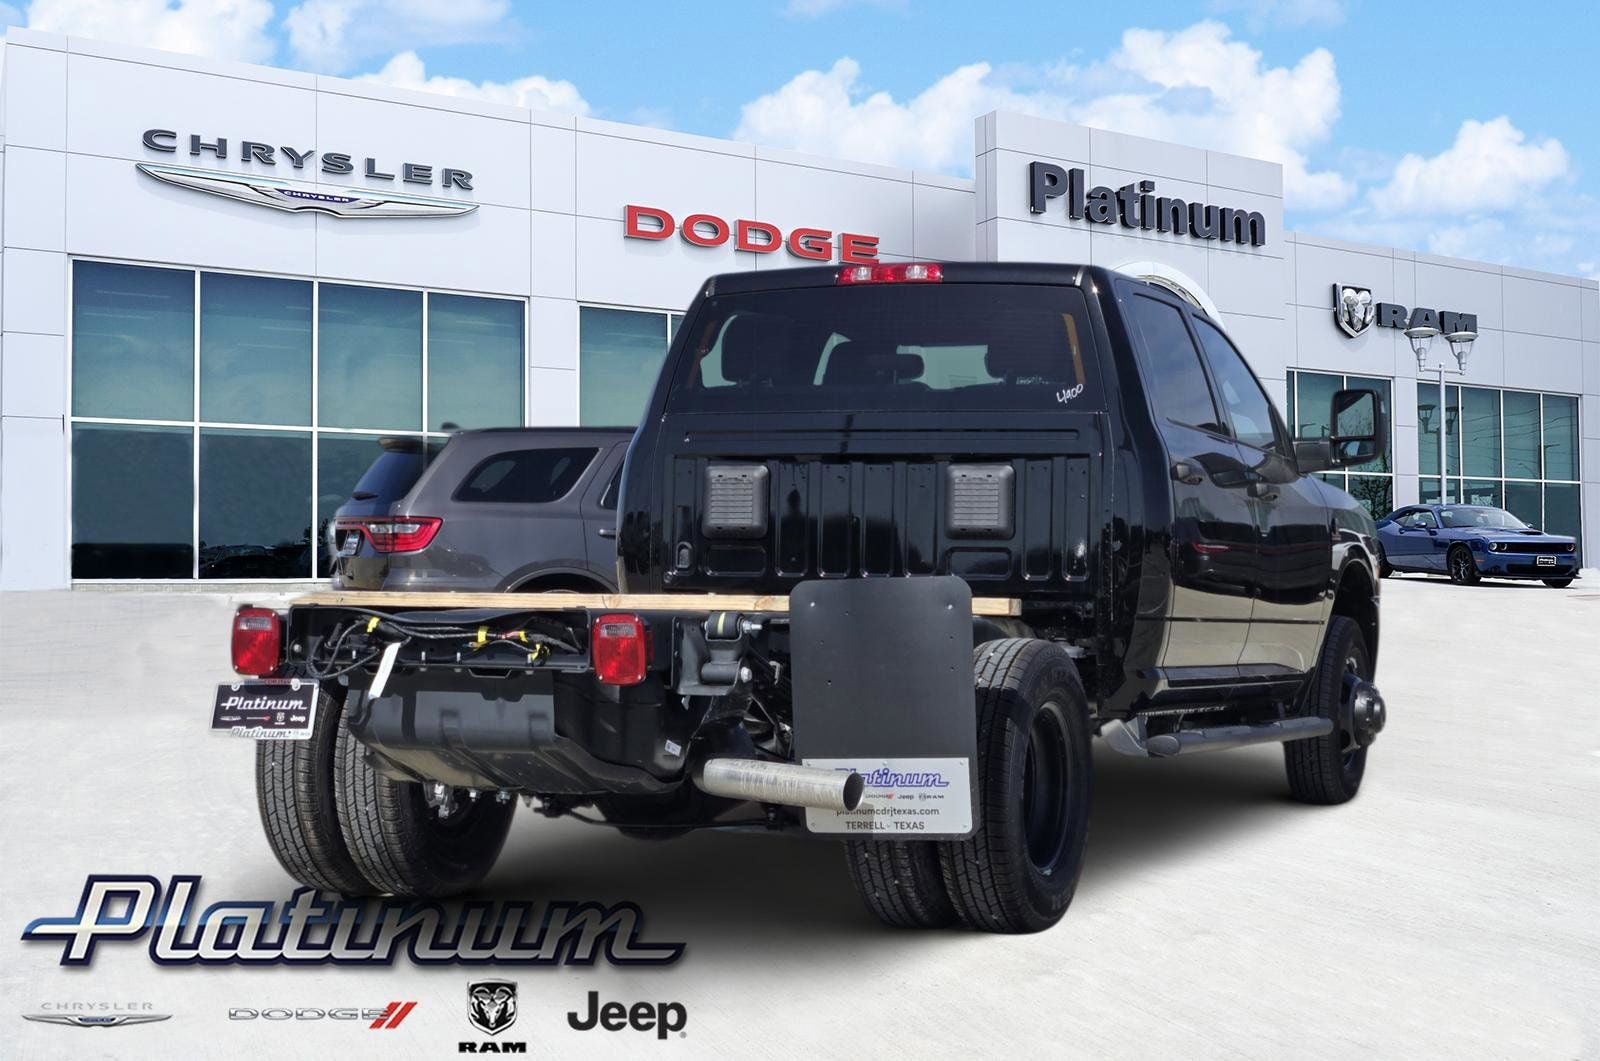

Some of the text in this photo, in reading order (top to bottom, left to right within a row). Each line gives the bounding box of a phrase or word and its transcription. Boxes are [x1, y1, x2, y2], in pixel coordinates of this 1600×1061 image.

[142, 127, 474, 190] CHRYSLER
[283, 190, 350, 202] CHRYSLER
[1029, 160, 1267, 247] Platinum
[623, 204, 880, 265] DODGE
[1376, 302, 1477, 334] RAM
[220, 696, 308, 710] Platinum
[231, 727, 289, 738] Platinum
[834, 767, 950, 788] atinum
[836, 806, 940, 817] pnumcdrjtexas.com
[846, 821, 925, 830] TERRELL TEXAS
